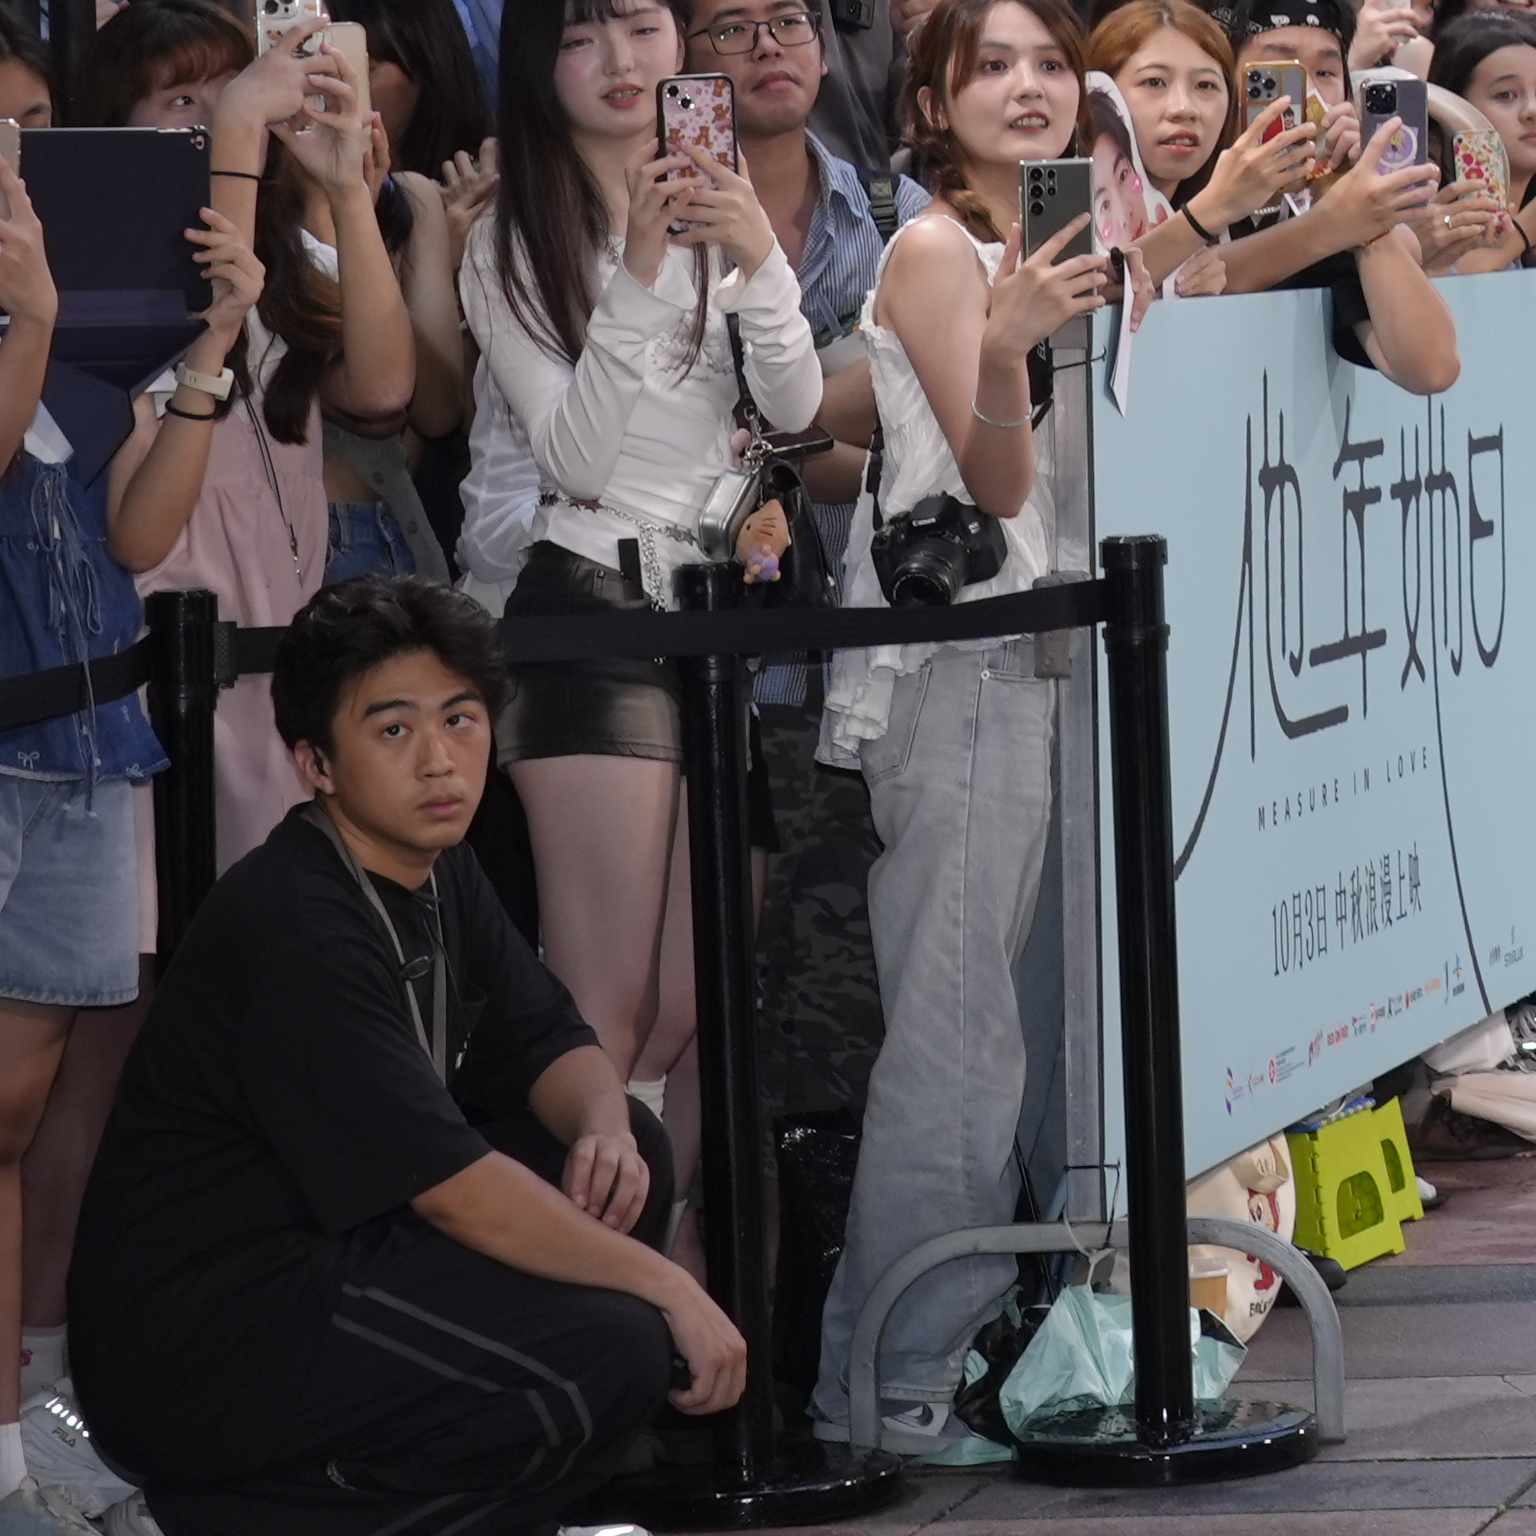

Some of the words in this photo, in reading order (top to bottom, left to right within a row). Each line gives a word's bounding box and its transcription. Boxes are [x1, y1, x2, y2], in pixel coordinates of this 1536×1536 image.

[1258, 778, 1340, 832] MEASURE
[1353, 767, 1370, 796] IN
[1386, 746, 1428, 783] LOVE
[1272, 883, 1328, 978] 10月3日
[1334, 840, 1422, 951] 中秋浪漫上映
